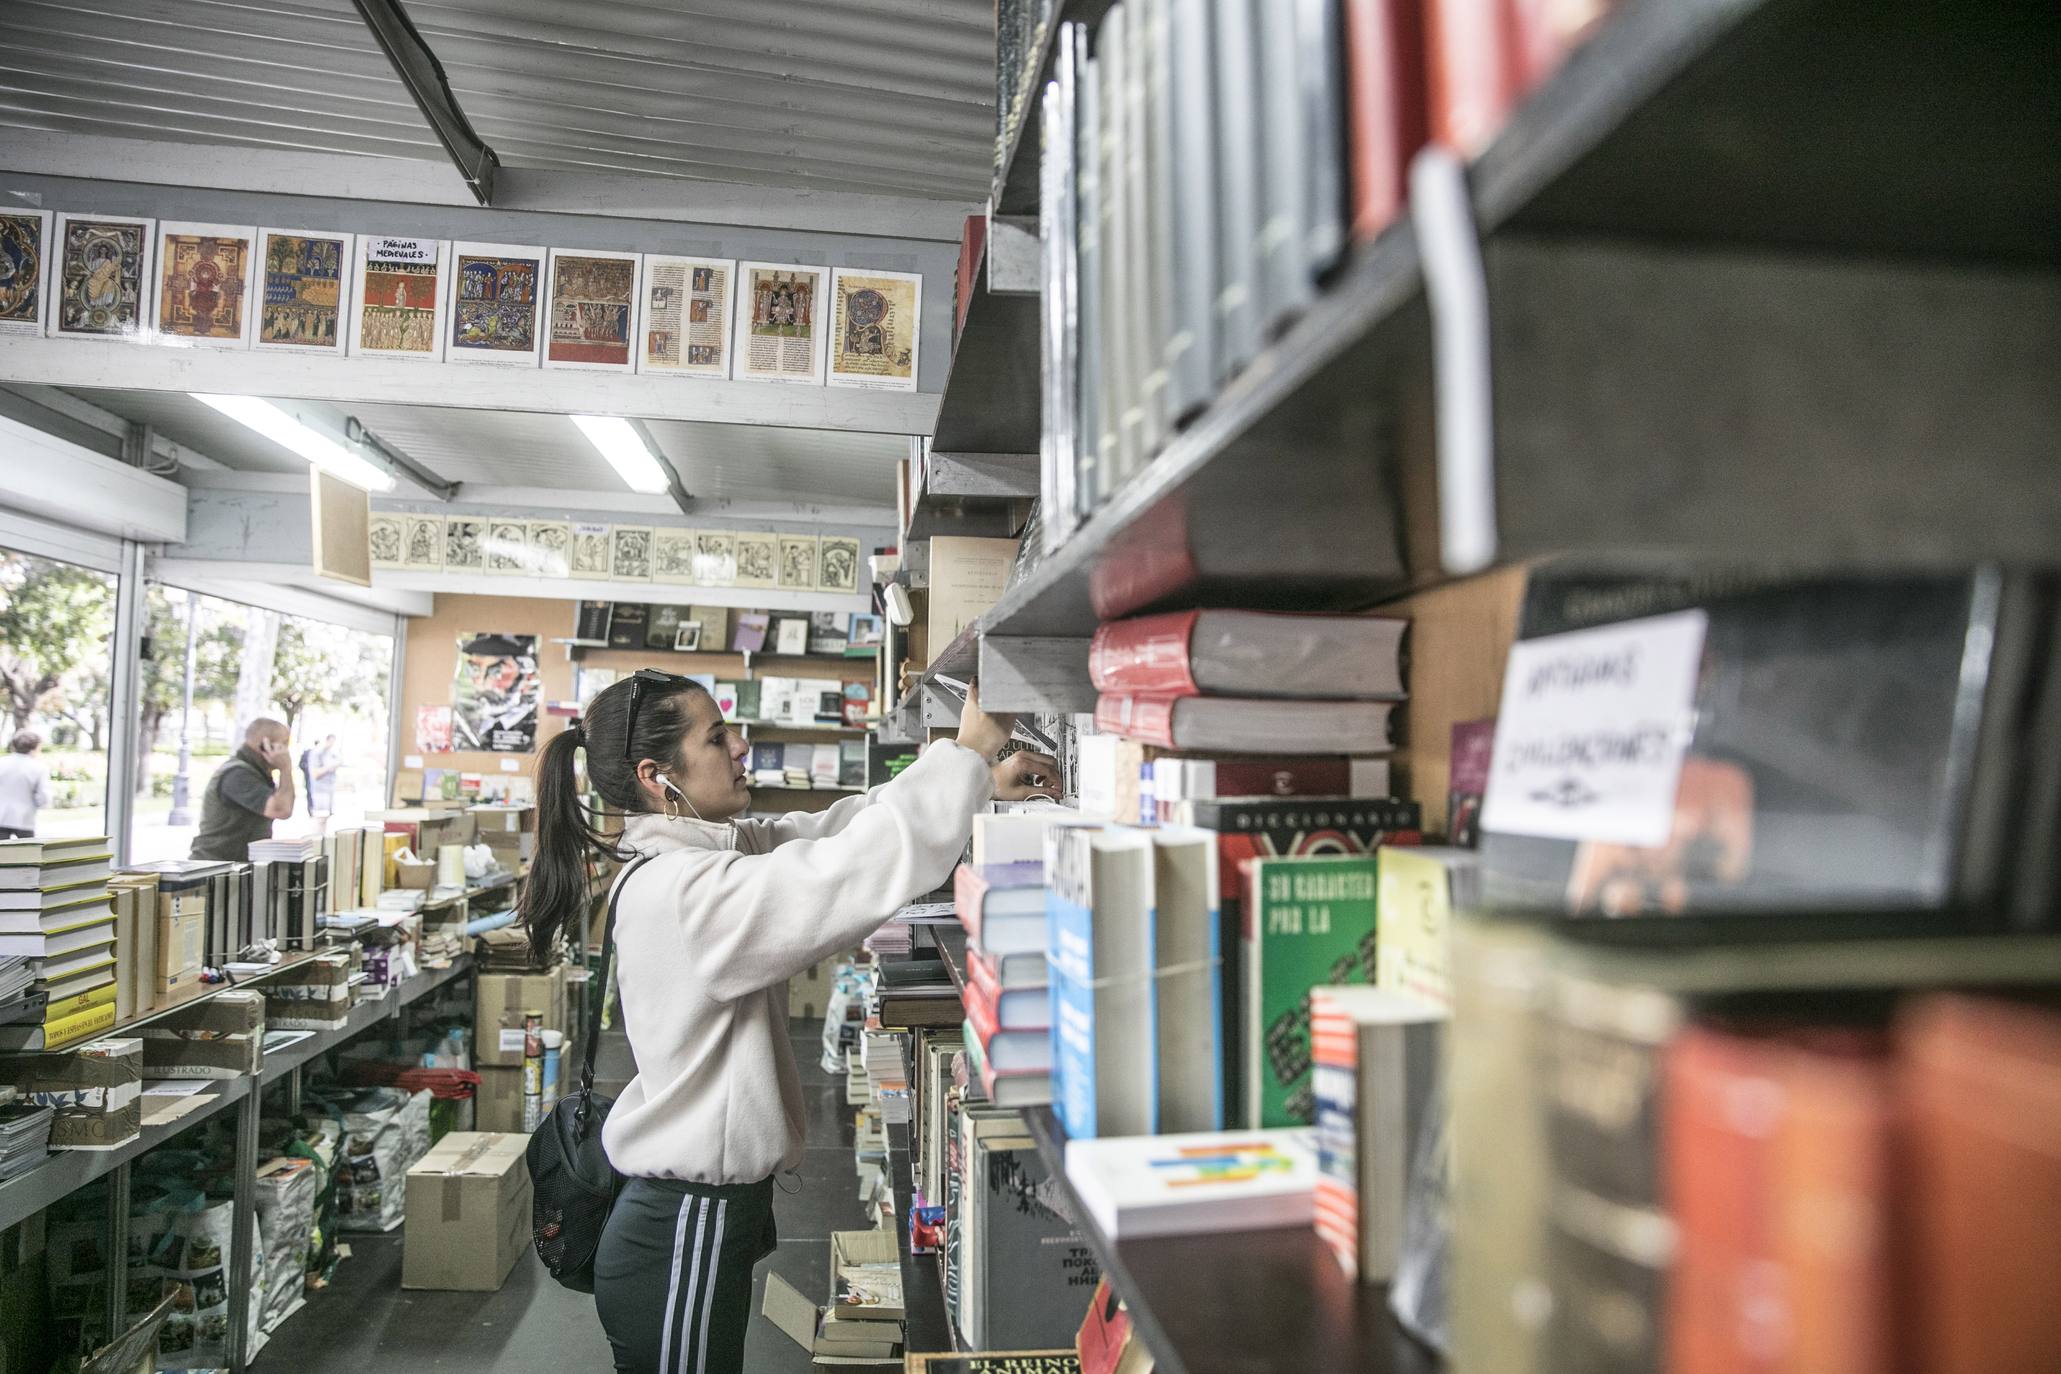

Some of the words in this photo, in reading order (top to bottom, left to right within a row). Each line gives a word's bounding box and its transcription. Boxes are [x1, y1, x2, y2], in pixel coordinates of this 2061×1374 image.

[376, 250, 424, 258] MEDIEVALES
[1236, 812, 1410, 830] DICCIONARIO
[154, 1067, 211, 1075] ILUSTRADO
[970, 1360, 996, 1370] EL
[1004, 1358, 1079, 1368] REINO
